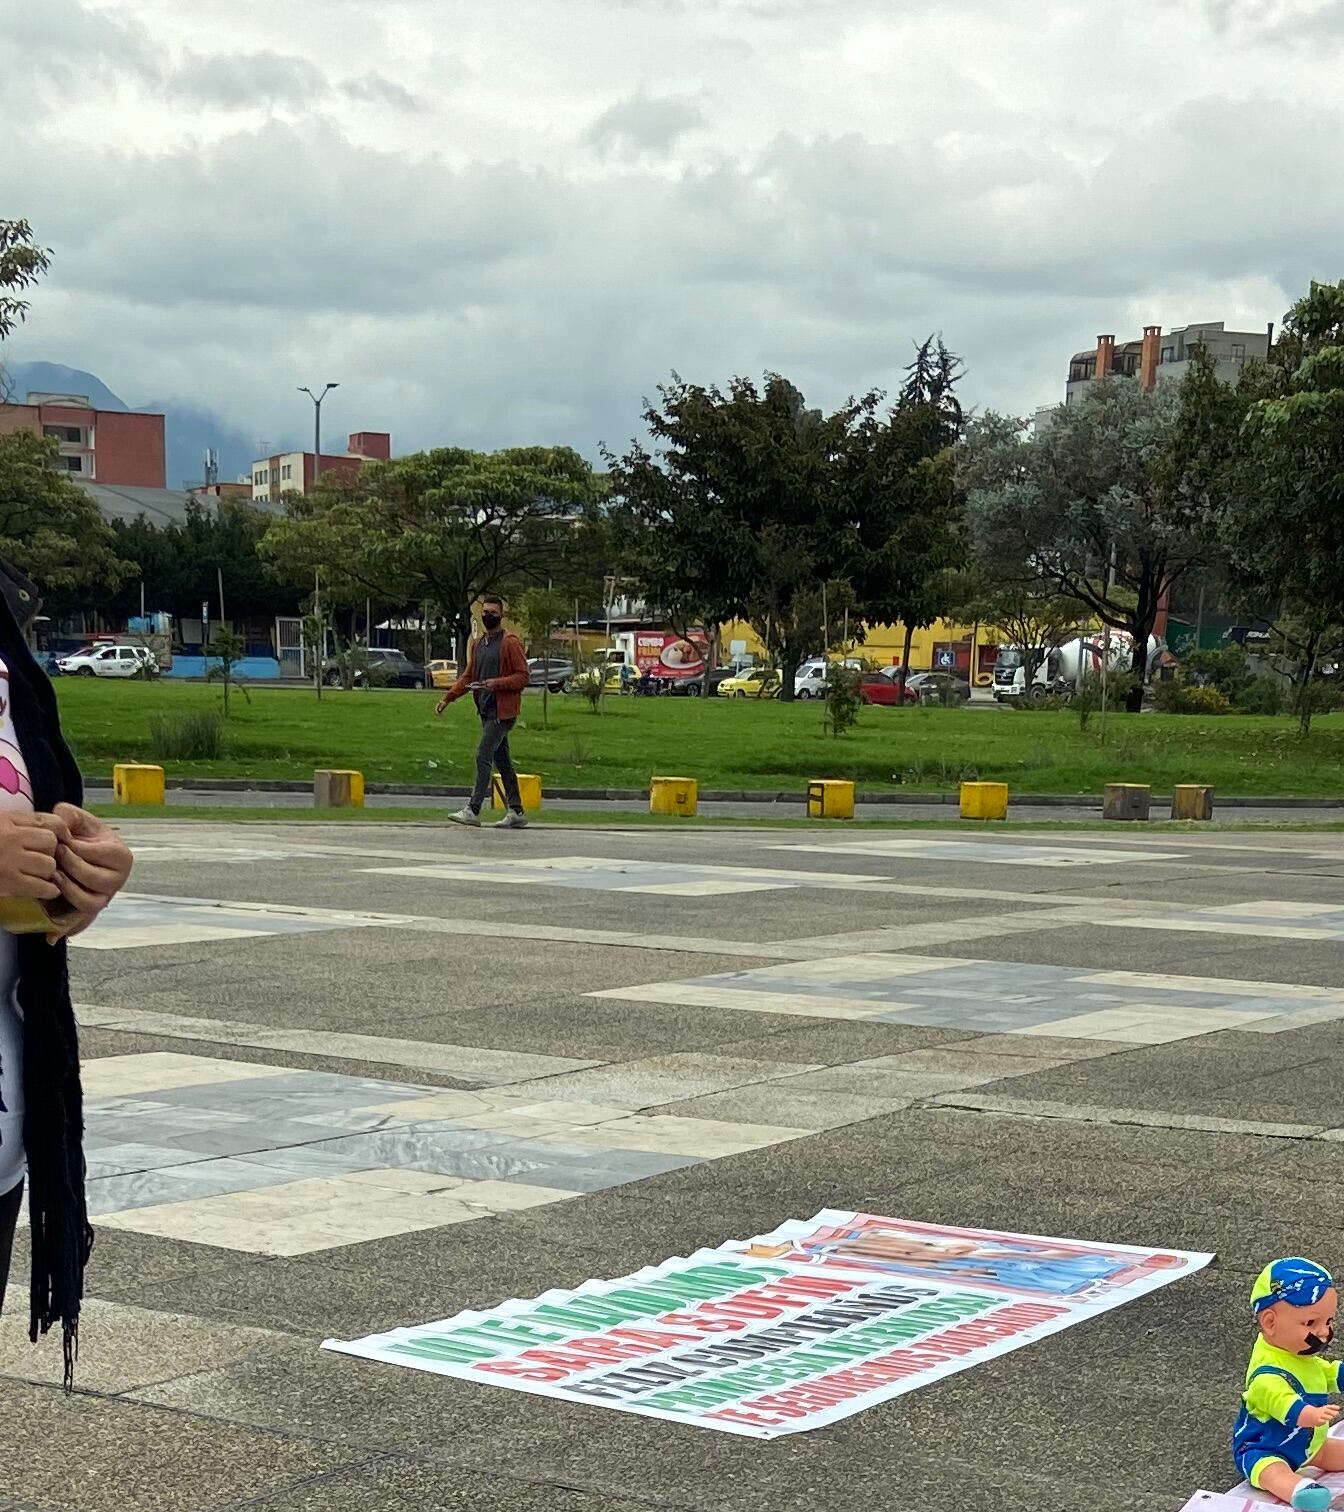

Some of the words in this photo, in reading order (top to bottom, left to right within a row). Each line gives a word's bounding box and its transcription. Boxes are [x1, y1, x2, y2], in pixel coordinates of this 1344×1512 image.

[447, 1318, 570, 1347] TE
[512, 1261, 794, 1334] OLVIDAMOS
[560, 1361, 706, 1399] FELIZ
[671, 1285, 940, 1368] CUMPLEAÑOS
[471, 1328, 706, 1383] SARA
[625, 1352, 855, 1413] PRINCESA
[810, 1293, 1009, 1357] HERMOSA!
[740, 1350, 952, 1418] SEGUIREMOS
[703, 1407, 786, 1428] TE
